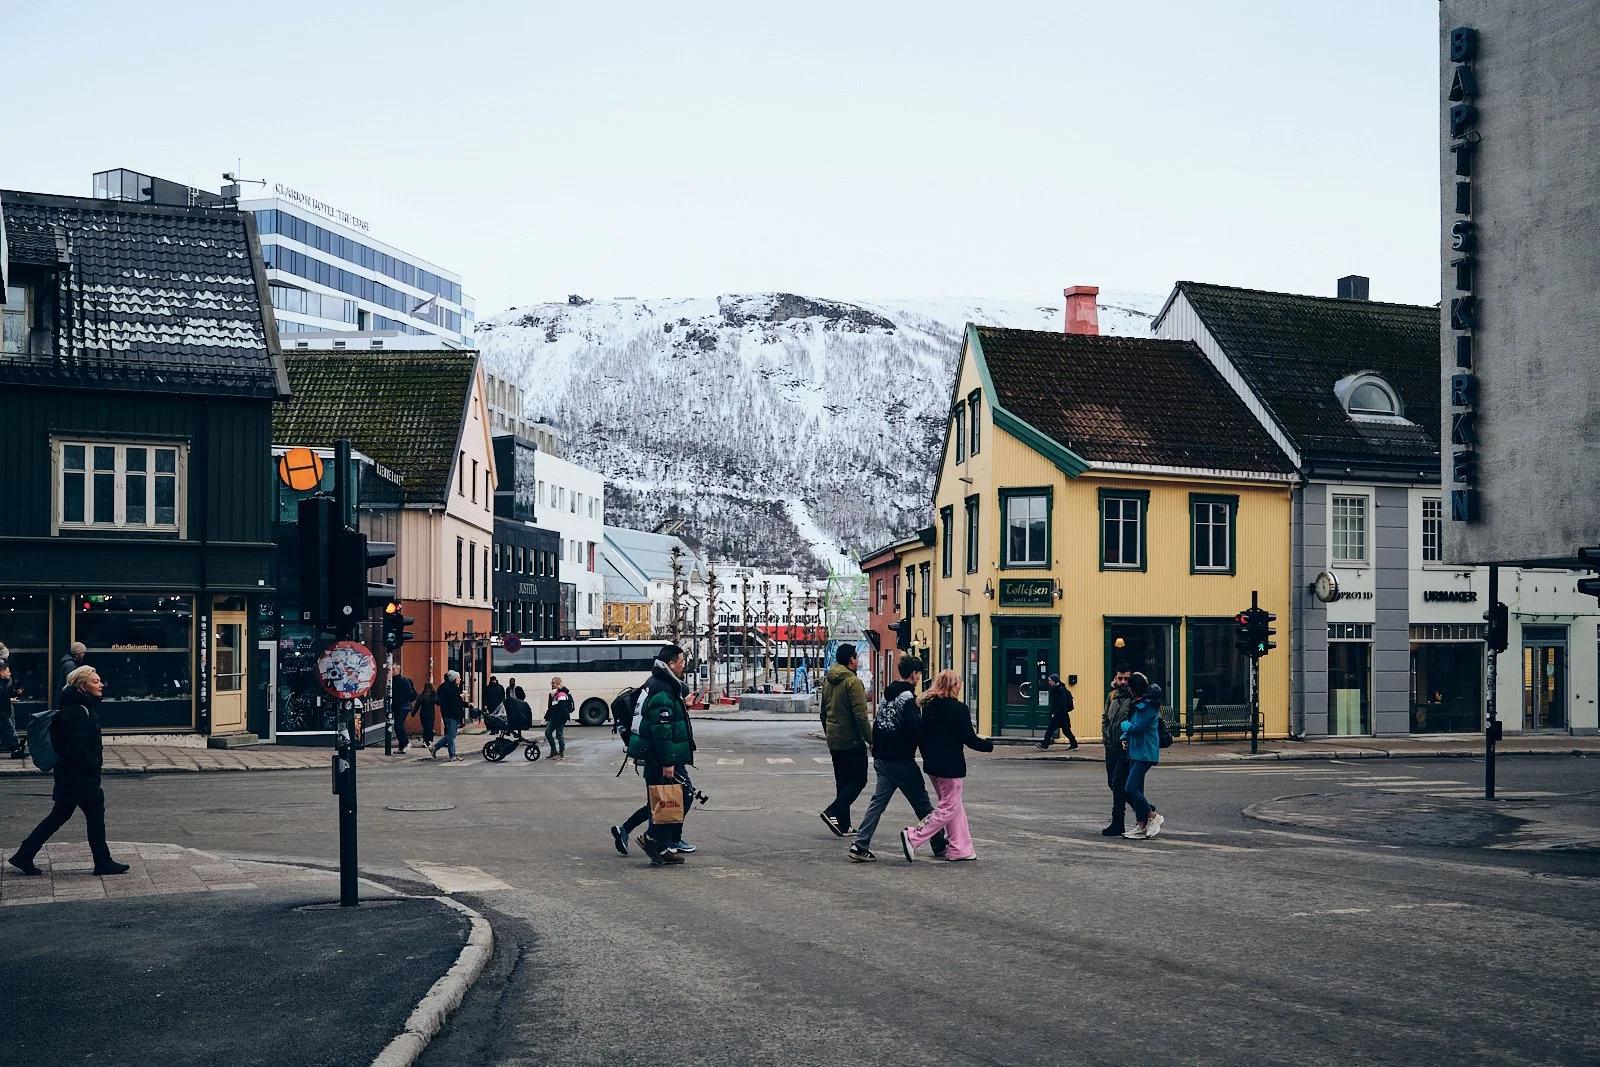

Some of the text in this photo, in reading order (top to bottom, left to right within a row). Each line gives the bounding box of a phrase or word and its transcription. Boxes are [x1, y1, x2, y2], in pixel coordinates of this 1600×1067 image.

[275, 183, 311, 206] CLARION
[312, 198, 335, 217] HOTEL
[1449, 27, 1477, 522] BAPTISTKIRKEN
[518, 582, 538, 596] JUSTITIA
[1005, 583, 1048, 596] Tollefsen
[1424, 591, 1478, 603] URMAKER
